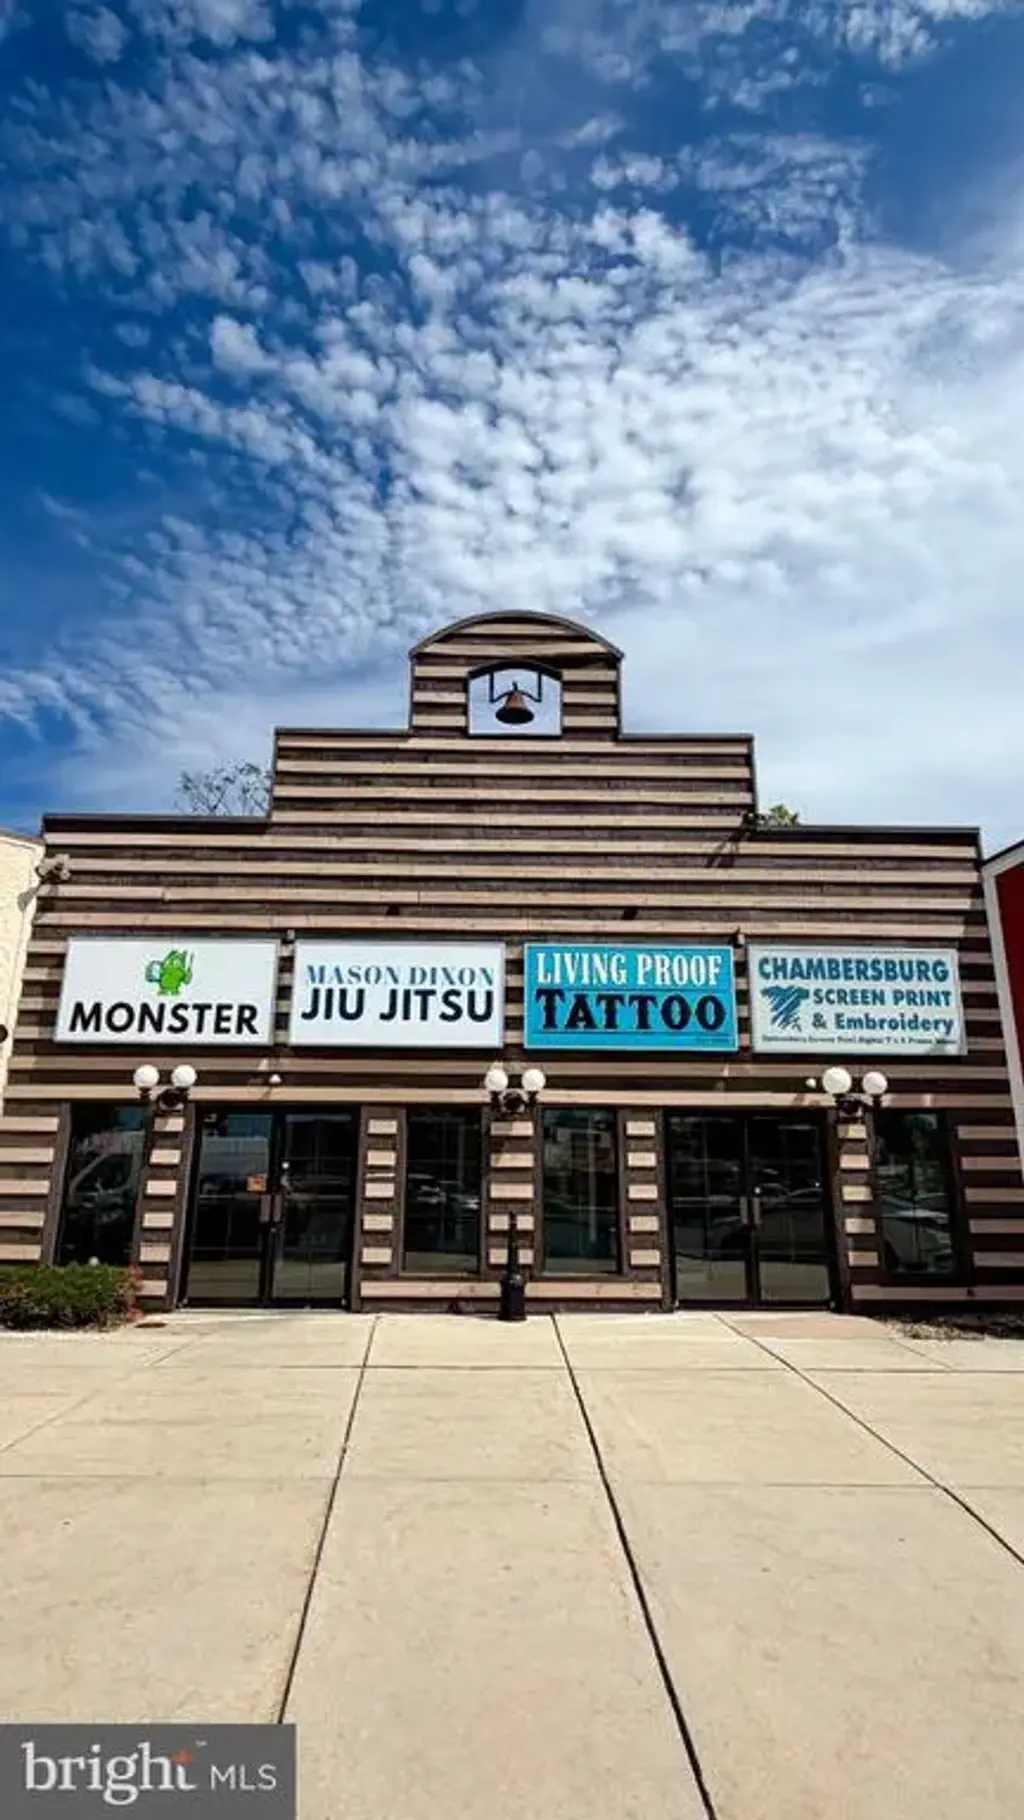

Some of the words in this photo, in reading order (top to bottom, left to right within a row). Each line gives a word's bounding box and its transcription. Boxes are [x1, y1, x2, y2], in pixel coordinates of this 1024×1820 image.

[306, 965, 400, 985] MASON
[409, 966, 494, 986] DIXON
[536, 952, 627, 985] LIVING
[636, 954, 722, 987] PROOF
[758, 957, 949, 982] CHAMBERSBURG
[301, 988, 365, 1021] JIU
[379, 988, 494, 1022] JITSU
[535, 988, 726, 1030] TATTOO
[812, 988, 885, 1006] SCREEN
[893, 990, 952, 1007] PRINT
[69, 1002, 259, 1035] MONSTER
[812, 1012, 828, 1030] &
[835, 1013, 954, 1035] Embroidery
